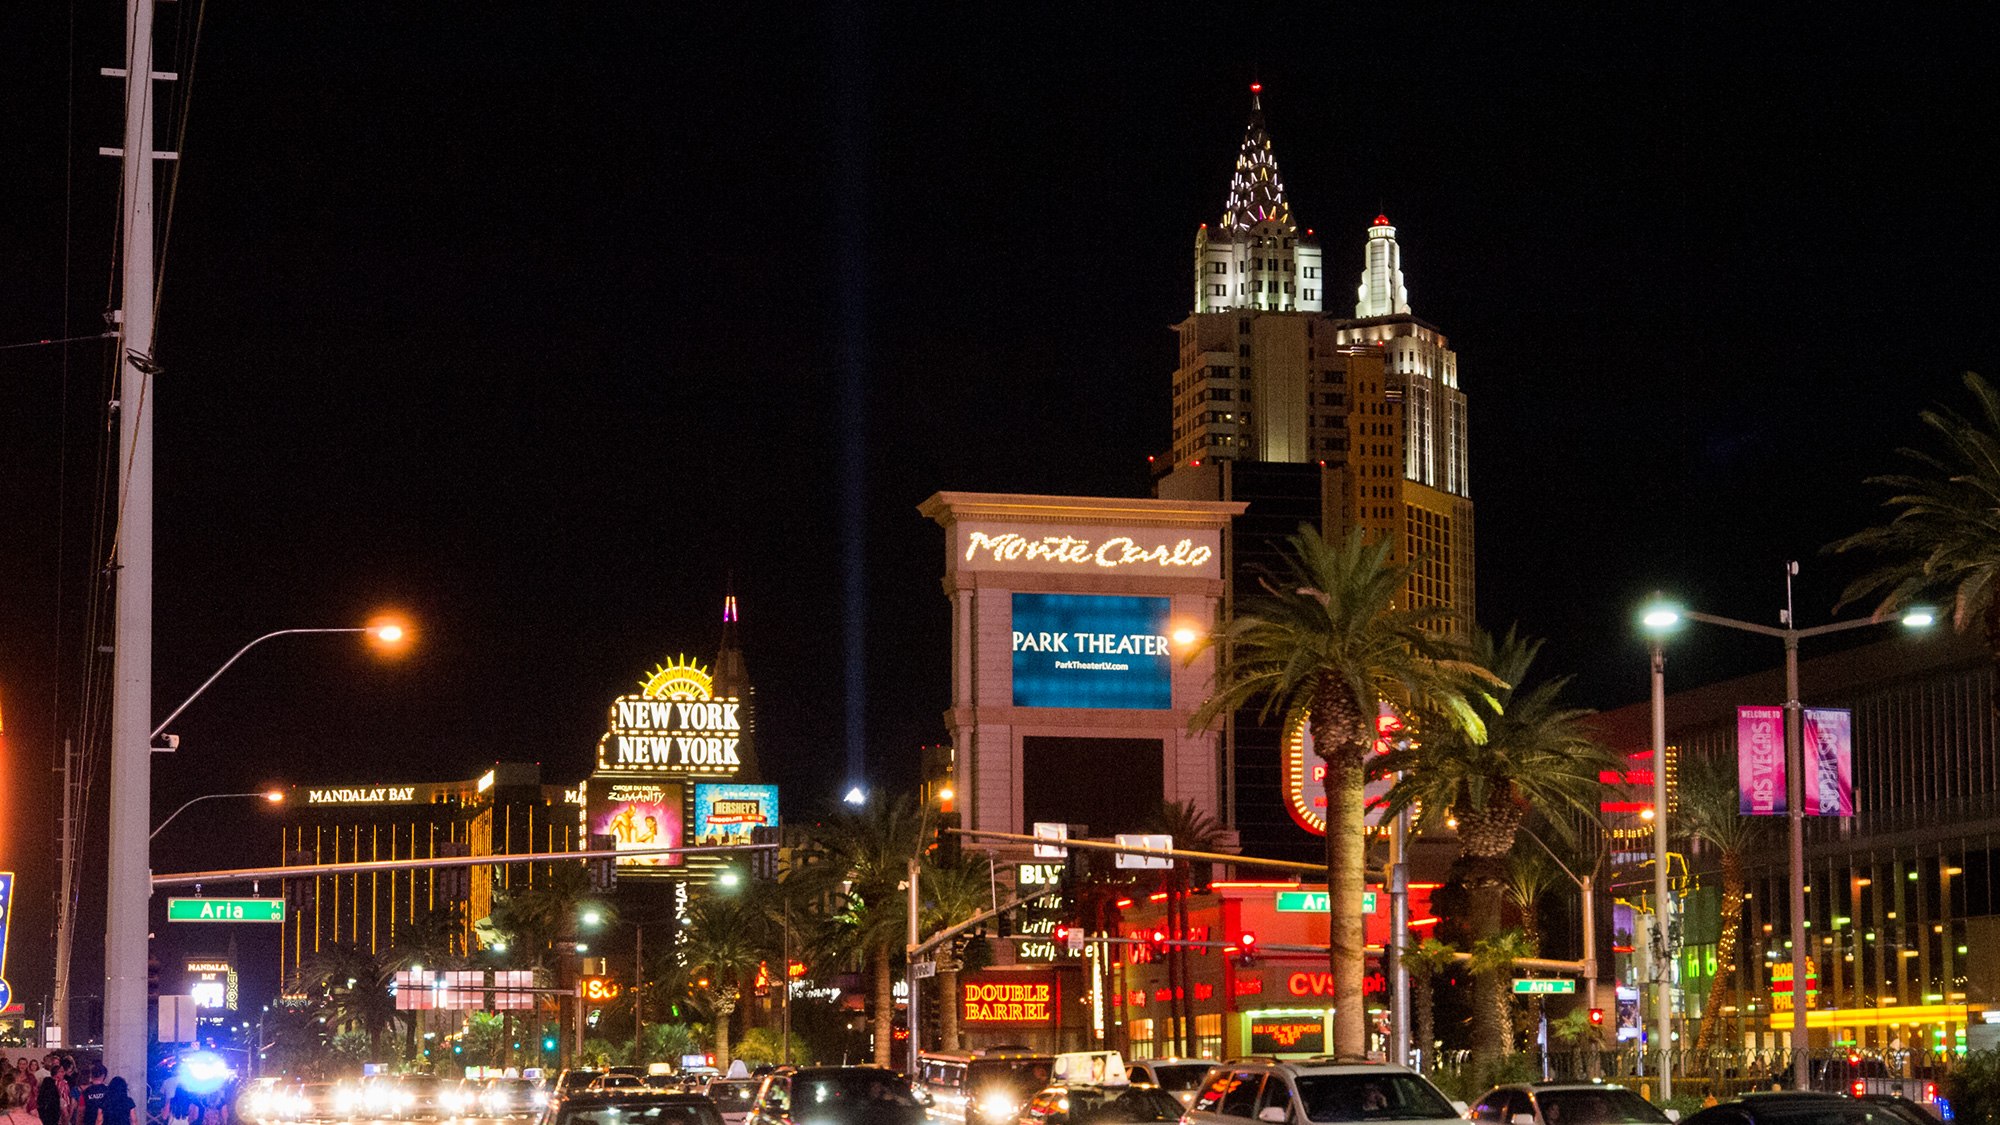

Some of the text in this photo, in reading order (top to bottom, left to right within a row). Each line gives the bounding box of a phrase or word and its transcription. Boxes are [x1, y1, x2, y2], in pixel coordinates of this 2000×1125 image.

[966, 532, 1212, 567] Monte Carlo
[1012, 631, 1170, 656] PARK THEATER
[1055, 661, 1129, 671] ParkTheaterLV.com
[618, 702, 740, 730] NEW YORK
[1741, 710, 1781, 719] WELCOME TO
[618, 737, 740, 764] NEW YORK
[1752, 721, 1774, 811] LAS VEGAS
[309, 787, 415, 803] MANDALAY BAY
[607, 790, 666, 807] ZUMANITY
[715, 801, 757, 815] HERSHEY'S
[1020, 865, 1065, 884] BLV
[200, 902, 244, 918] Aria
[271, 901, 281, 909] PL
[1302, 893, 1331, 910] Ari
[271, 912, 281, 920] 00
[201, 972, 217, 981] BAY
[966, 984, 1050, 1002] DOUBLE
[1529, 981, 1554, 992] Aria
[1772, 993, 1817, 1010] PALE
[966, 1003, 1050, 1021] BARREL
